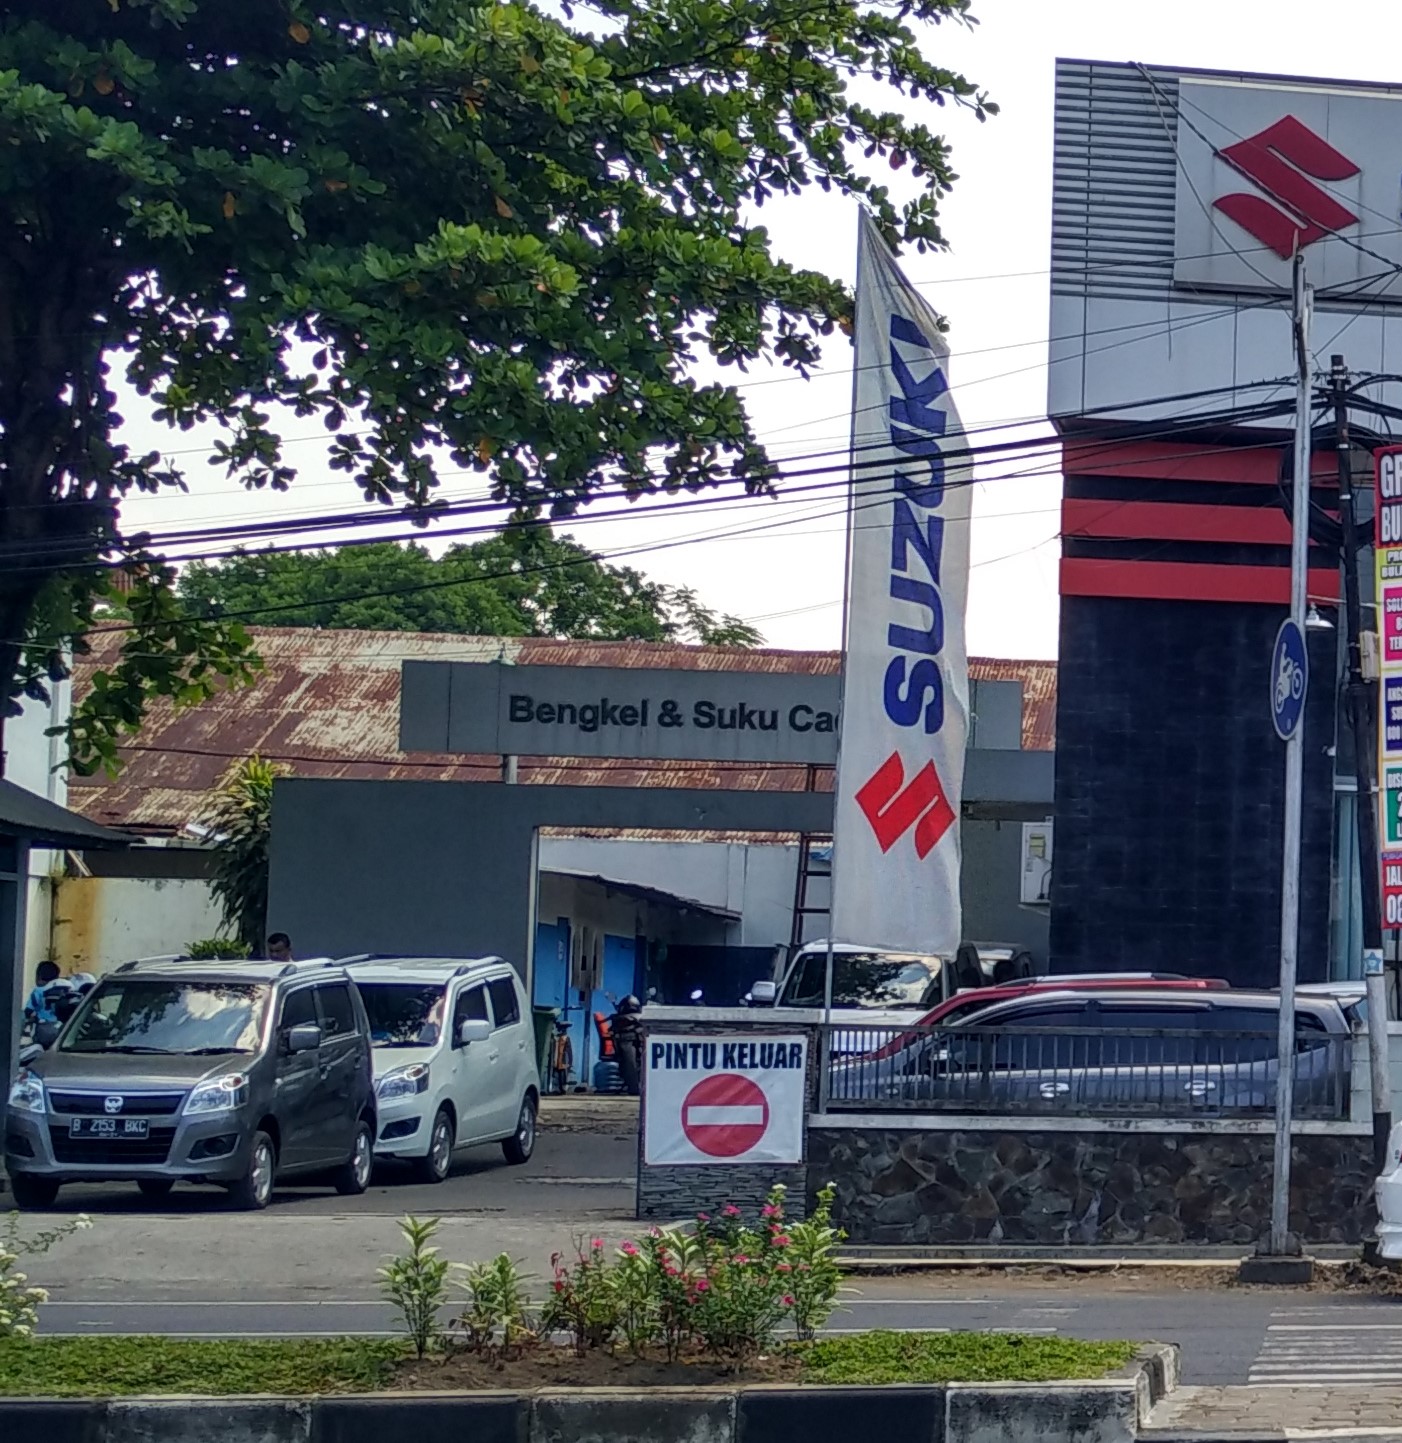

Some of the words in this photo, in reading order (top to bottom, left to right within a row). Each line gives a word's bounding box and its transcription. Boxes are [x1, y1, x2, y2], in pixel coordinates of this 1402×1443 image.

[884, 314, 948, 735] SUZUKI
[509, 694, 648, 732] Bengkel
[657, 699, 684, 728] &
[693, 700, 779, 731] Suku
[651, 1042, 717, 1069] PINTU
[722, 1042, 803, 1070] KELUAR
[72, 1118, 81, 1131] B
